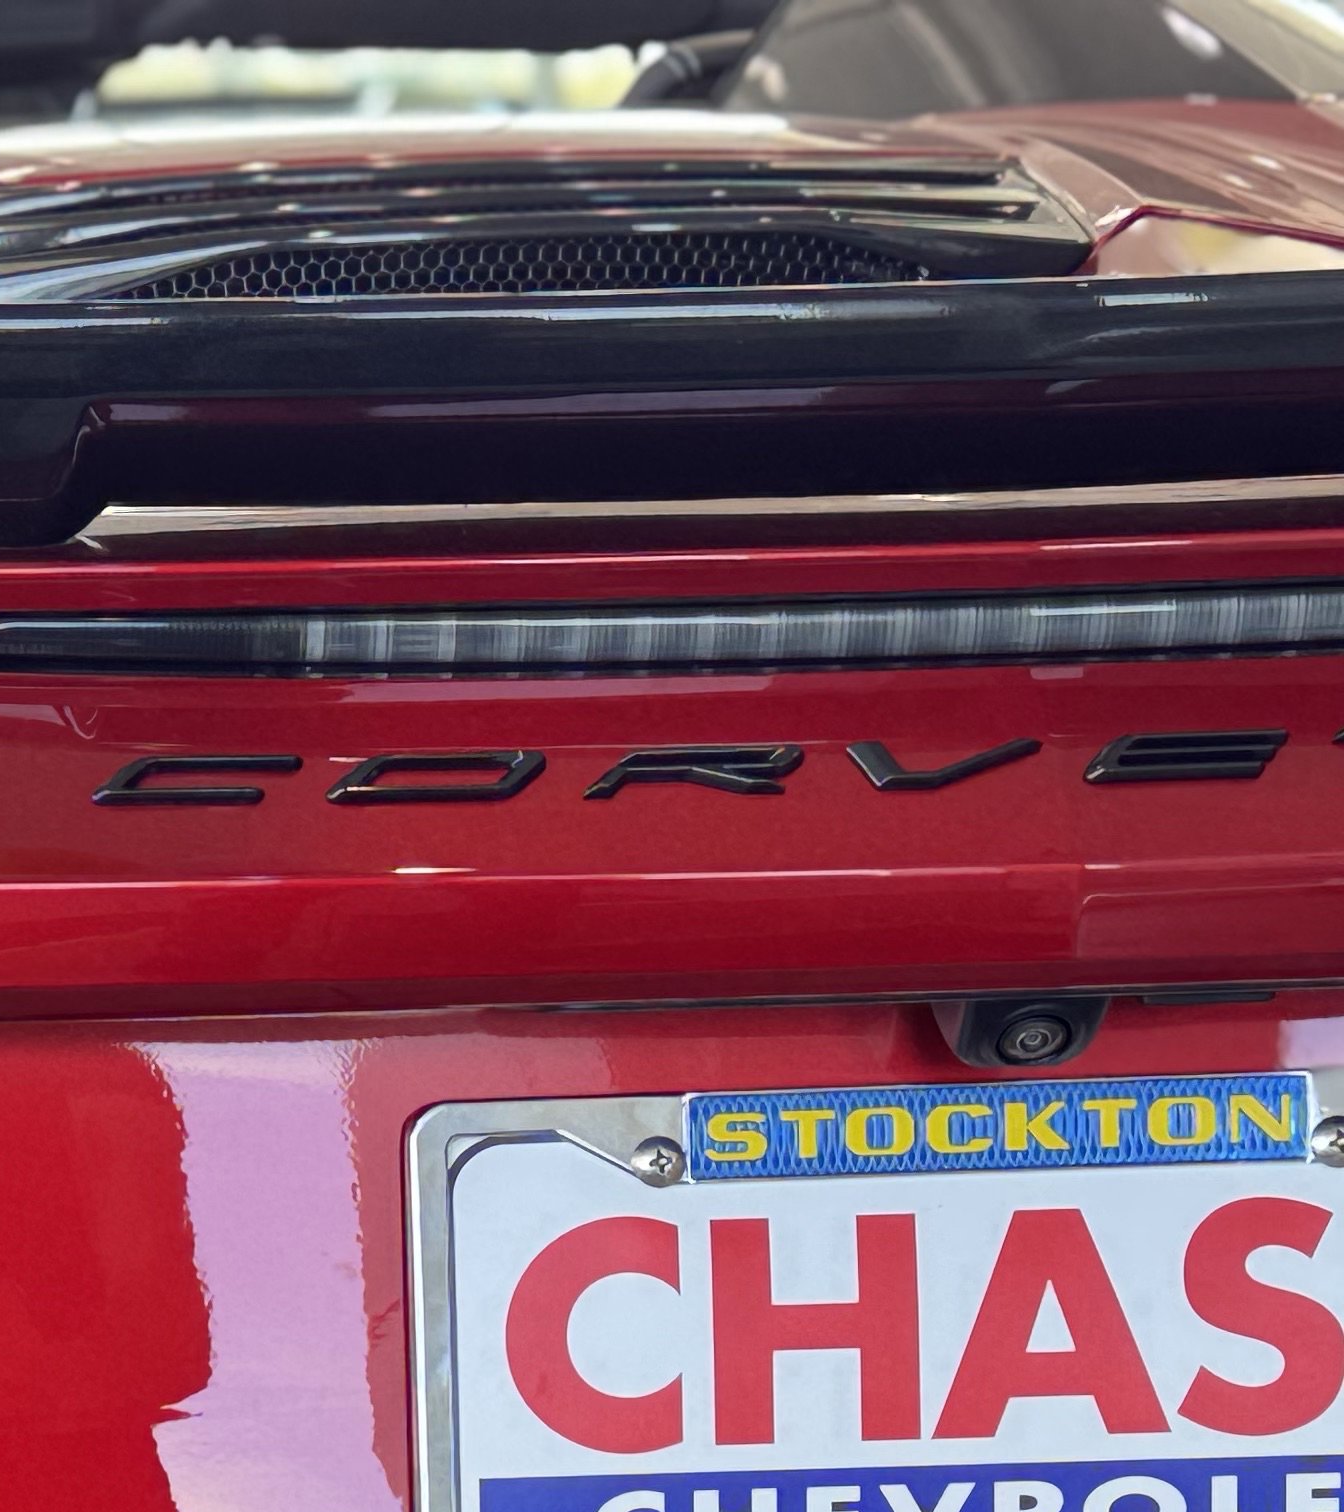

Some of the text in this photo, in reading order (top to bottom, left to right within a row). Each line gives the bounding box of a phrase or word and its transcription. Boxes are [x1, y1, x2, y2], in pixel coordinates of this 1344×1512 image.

[92, 728, 1344, 805] CORVE
[704, 1093, 1292, 1163] STOCKTON
[504, 1196, 1344, 1455] CHAS
